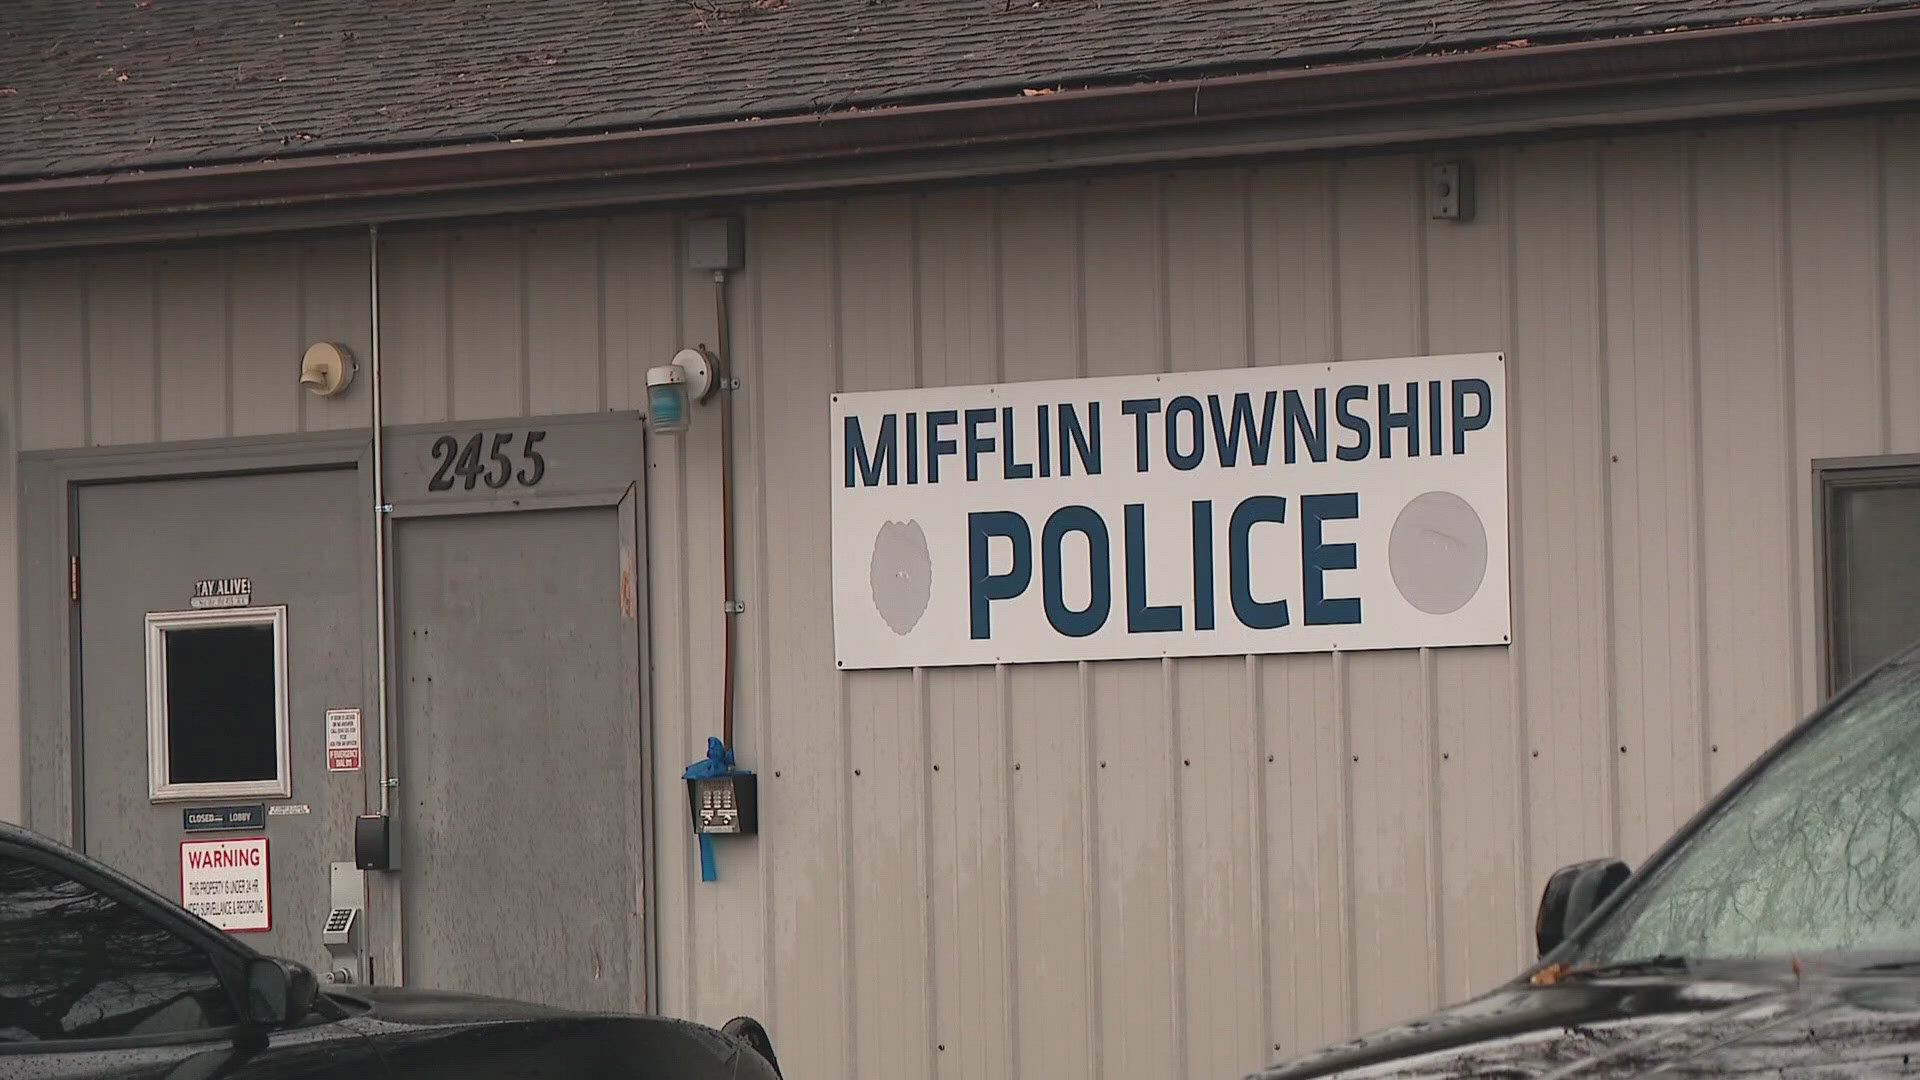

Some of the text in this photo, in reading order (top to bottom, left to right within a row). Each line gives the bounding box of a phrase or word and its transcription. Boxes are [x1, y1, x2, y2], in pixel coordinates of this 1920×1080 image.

[843, 378, 1493, 488] MIFFLIN TOWNSHIP
[428, 431, 546, 491] 2455
[967, 492, 1362, 640] POLICE
[188, 848, 260, 869] WARNING
[200, 880, 223, 895] PROPERTY
[236, 900, 264, 914] RECORDING
